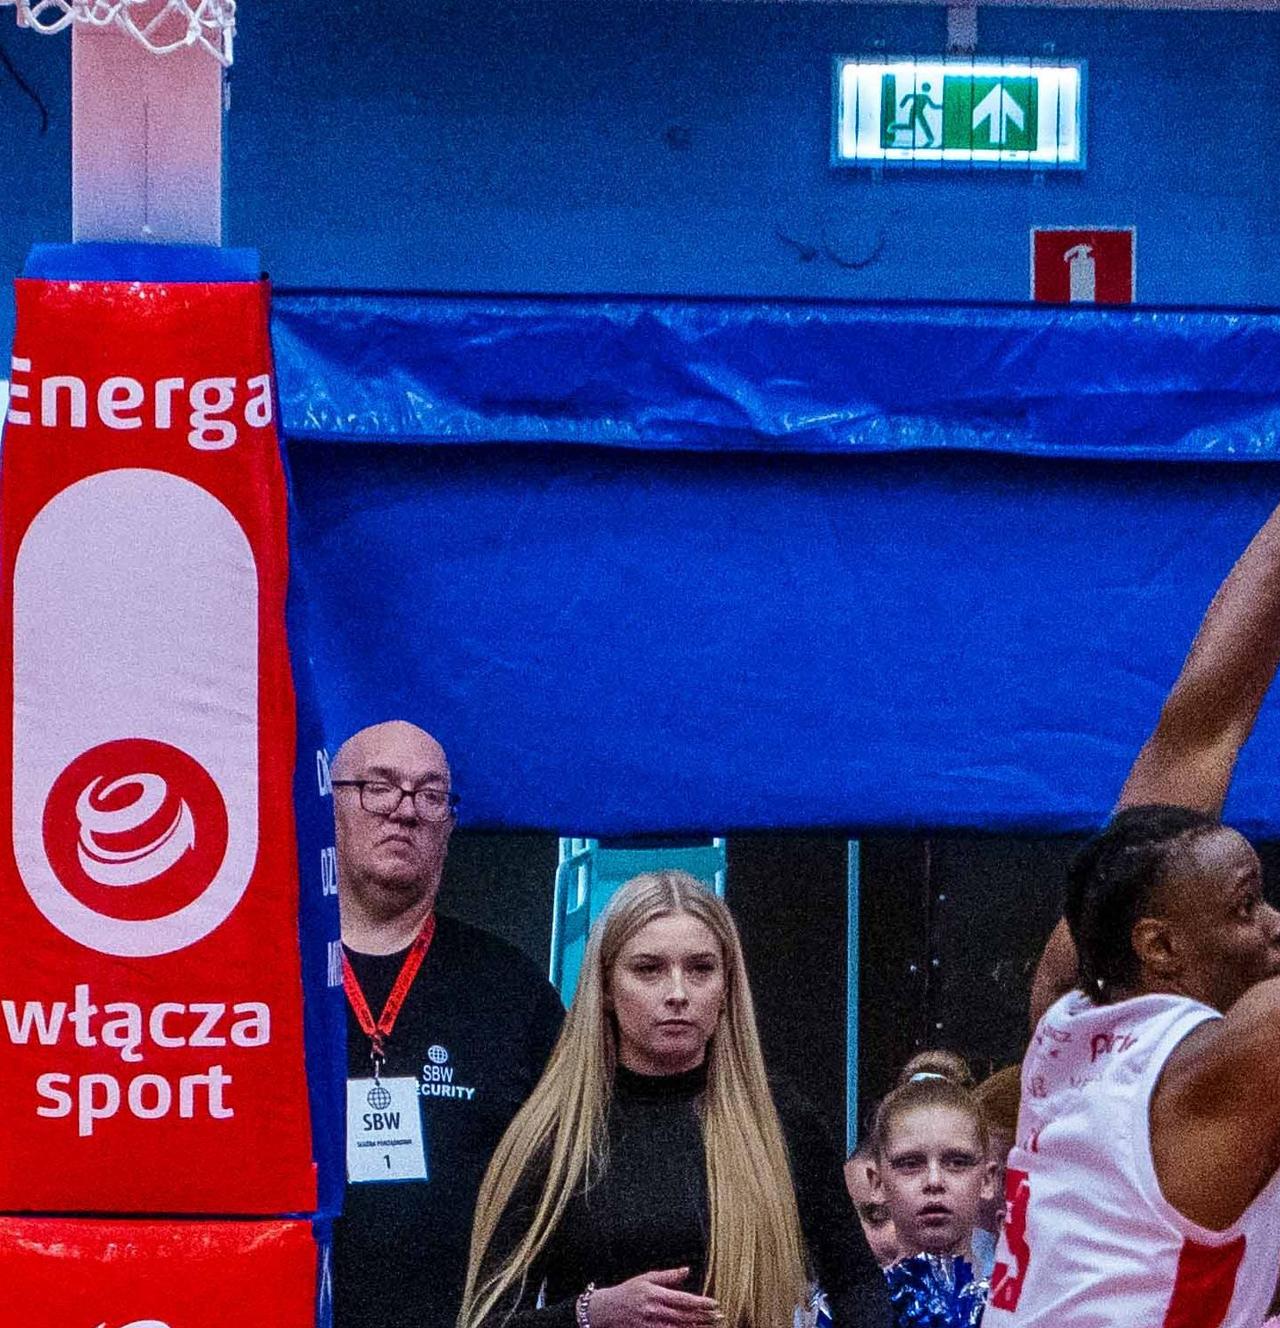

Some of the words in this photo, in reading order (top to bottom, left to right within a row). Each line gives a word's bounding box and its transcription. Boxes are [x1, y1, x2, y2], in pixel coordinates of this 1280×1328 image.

[2, 984, 271, 1062] włącza
[423, 1065, 453, 1082] SBW
[36, 1065, 234, 1137] sport
[363, 1112, 400, 1131] SBW
[383, 1154, 391, 1170] 1
